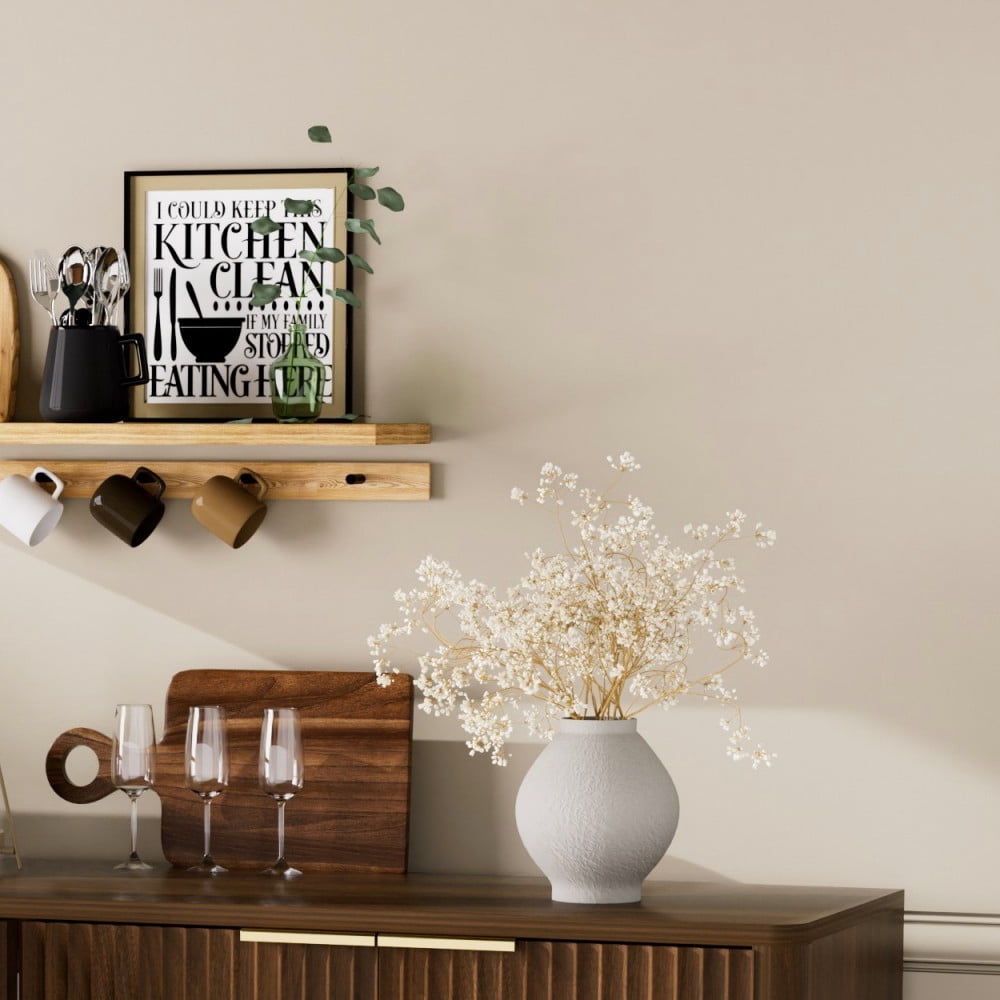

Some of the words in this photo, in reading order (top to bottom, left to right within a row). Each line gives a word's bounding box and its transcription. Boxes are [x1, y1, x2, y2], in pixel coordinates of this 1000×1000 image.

[157, 201, 162, 219] I
[168, 200, 226, 219] COULD
[232, 200, 276, 218] KEEP
[153, 221, 327, 269] KITCHEN
[210, 261, 325, 299] CLEAN
[246, 313, 258, 330] IF
[262, 313, 280, 330] MY
[284, 313, 328, 330] FAMILY
[149, 364, 251, 398] EATING
